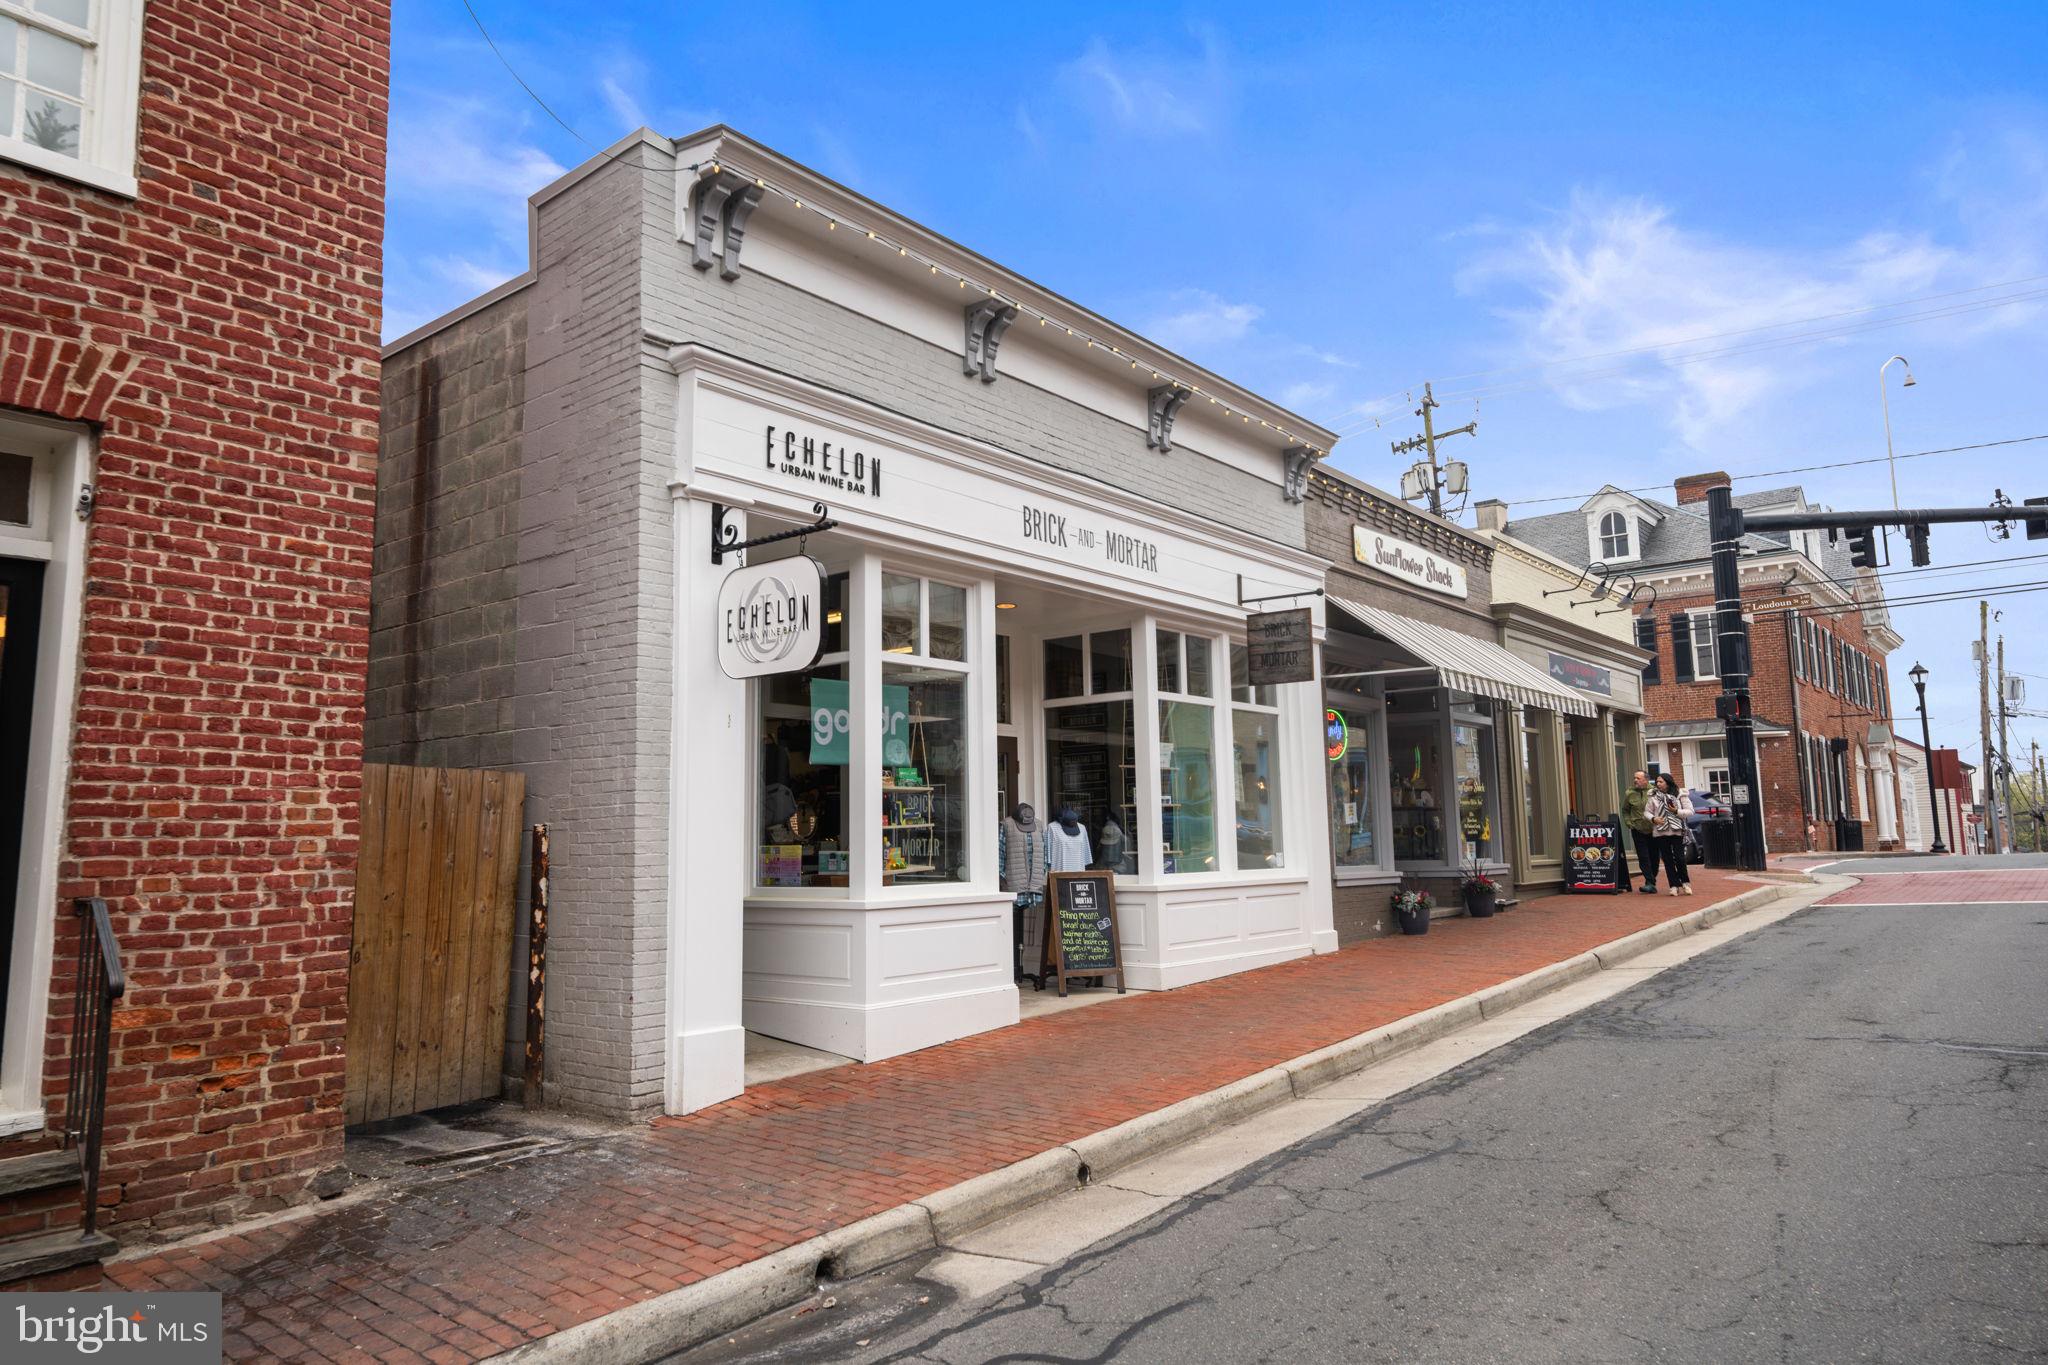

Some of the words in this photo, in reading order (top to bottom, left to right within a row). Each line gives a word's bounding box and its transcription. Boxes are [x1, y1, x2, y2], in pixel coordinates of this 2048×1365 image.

[766, 425, 881, 498] ECHELON
[781, 462, 815, 481] URBAN
[818, 472, 845, 489] WINE
[847, 481, 866, 495] BAR
[1023, 505, 1068, 548] BRICK
[1078, 528, 1095, 549] AND
[1105, 530, 1158, 573] MORTAR
[1375, 537, 1424, 577] Sunflower
[1426, 557, 1453, 588] Shack
[1752, 600, 1793, 611] Loudoun
[727, 594, 809, 643] ECHELON
[1264, 621, 1291, 639] BRICK
[1261, 651, 1298, 668] MORTAR
[814, 706, 906, 746] godr
[907, 795, 935, 814] BRICK
[1570, 828, 1615, 838] HAPPY
[1578, 837, 1606, 845] HOUR
[902, 838, 940, 857] MORTAR
